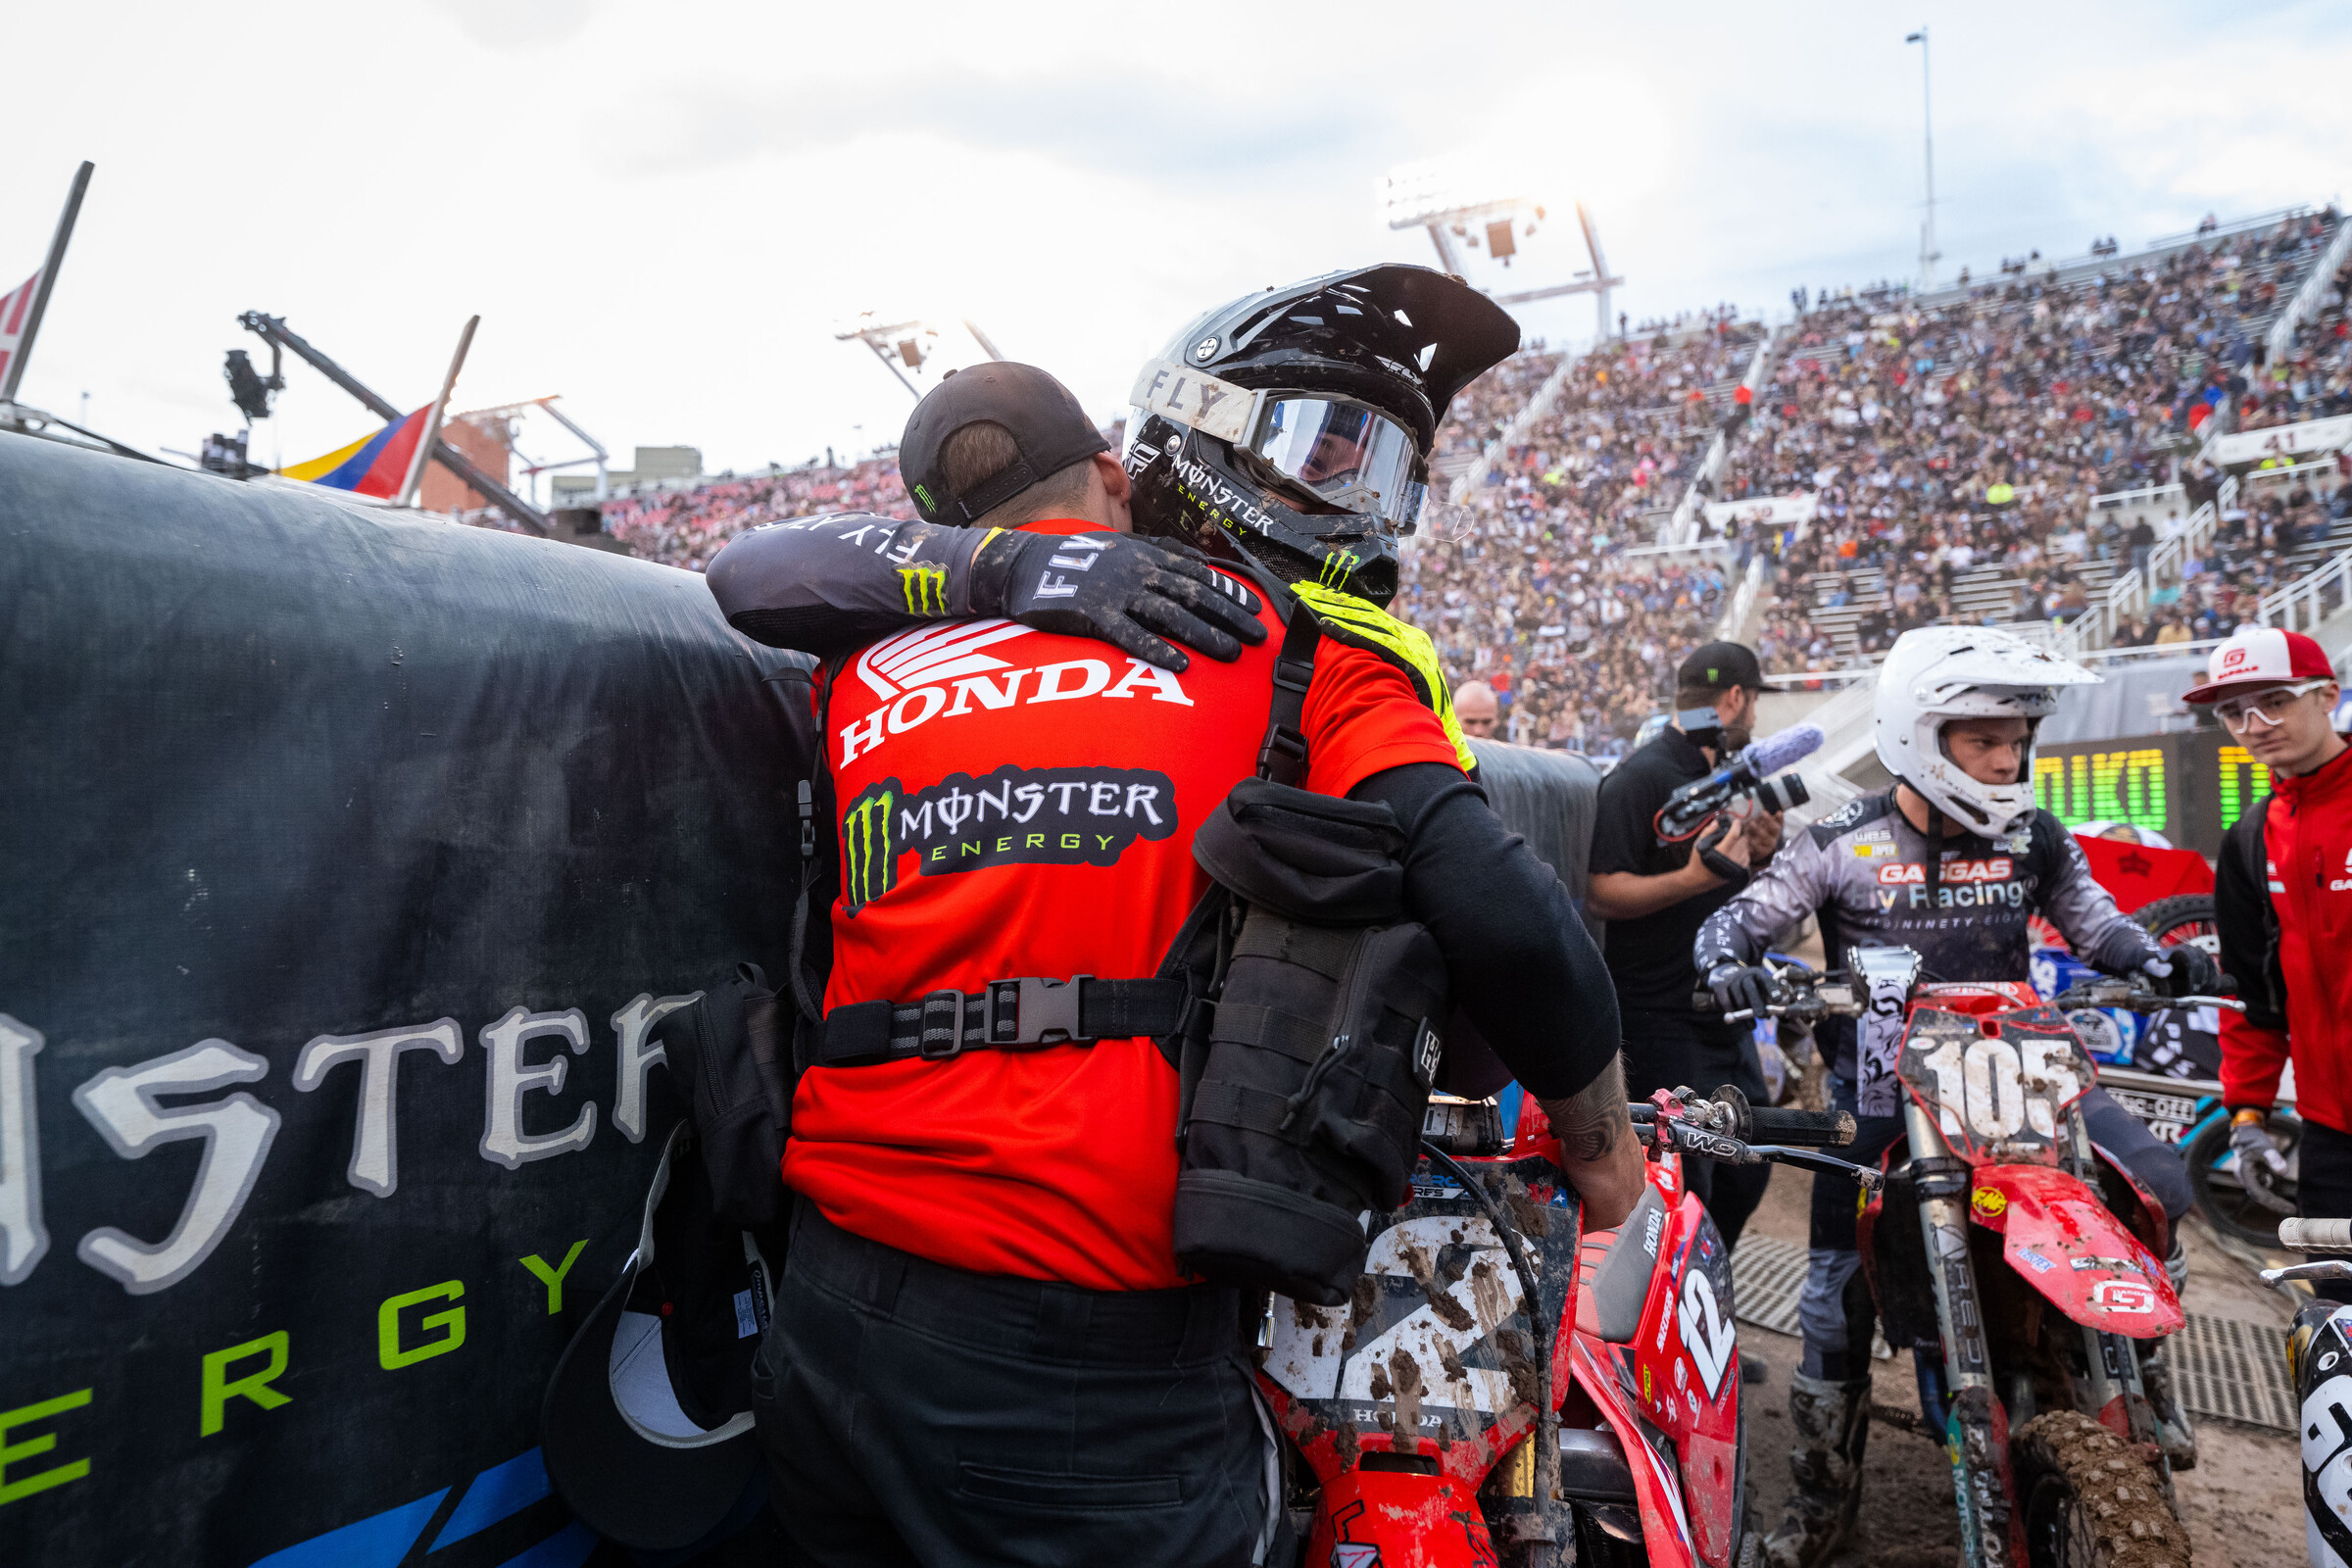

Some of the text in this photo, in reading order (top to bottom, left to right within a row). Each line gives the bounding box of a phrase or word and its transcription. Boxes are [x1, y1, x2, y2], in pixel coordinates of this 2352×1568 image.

[1146, 368, 1230, 420] FLY
[1171, 454, 1274, 536] MONSTER
[1178, 484, 1247, 536] ENERGY
[1032, 534, 1117, 601] FLY
[839, 657, 1195, 770] HONDA
[900, 778, 1163, 841] MONSTER
[931, 833, 1114, 861] ENERGY
[1879, 858, 2012, 885] GAGAS
[1923, 1038, 2082, 1139] 105
[1642, 1207, 1663, 1260] HONDA
[1677, 1267, 1736, 1402] 12
